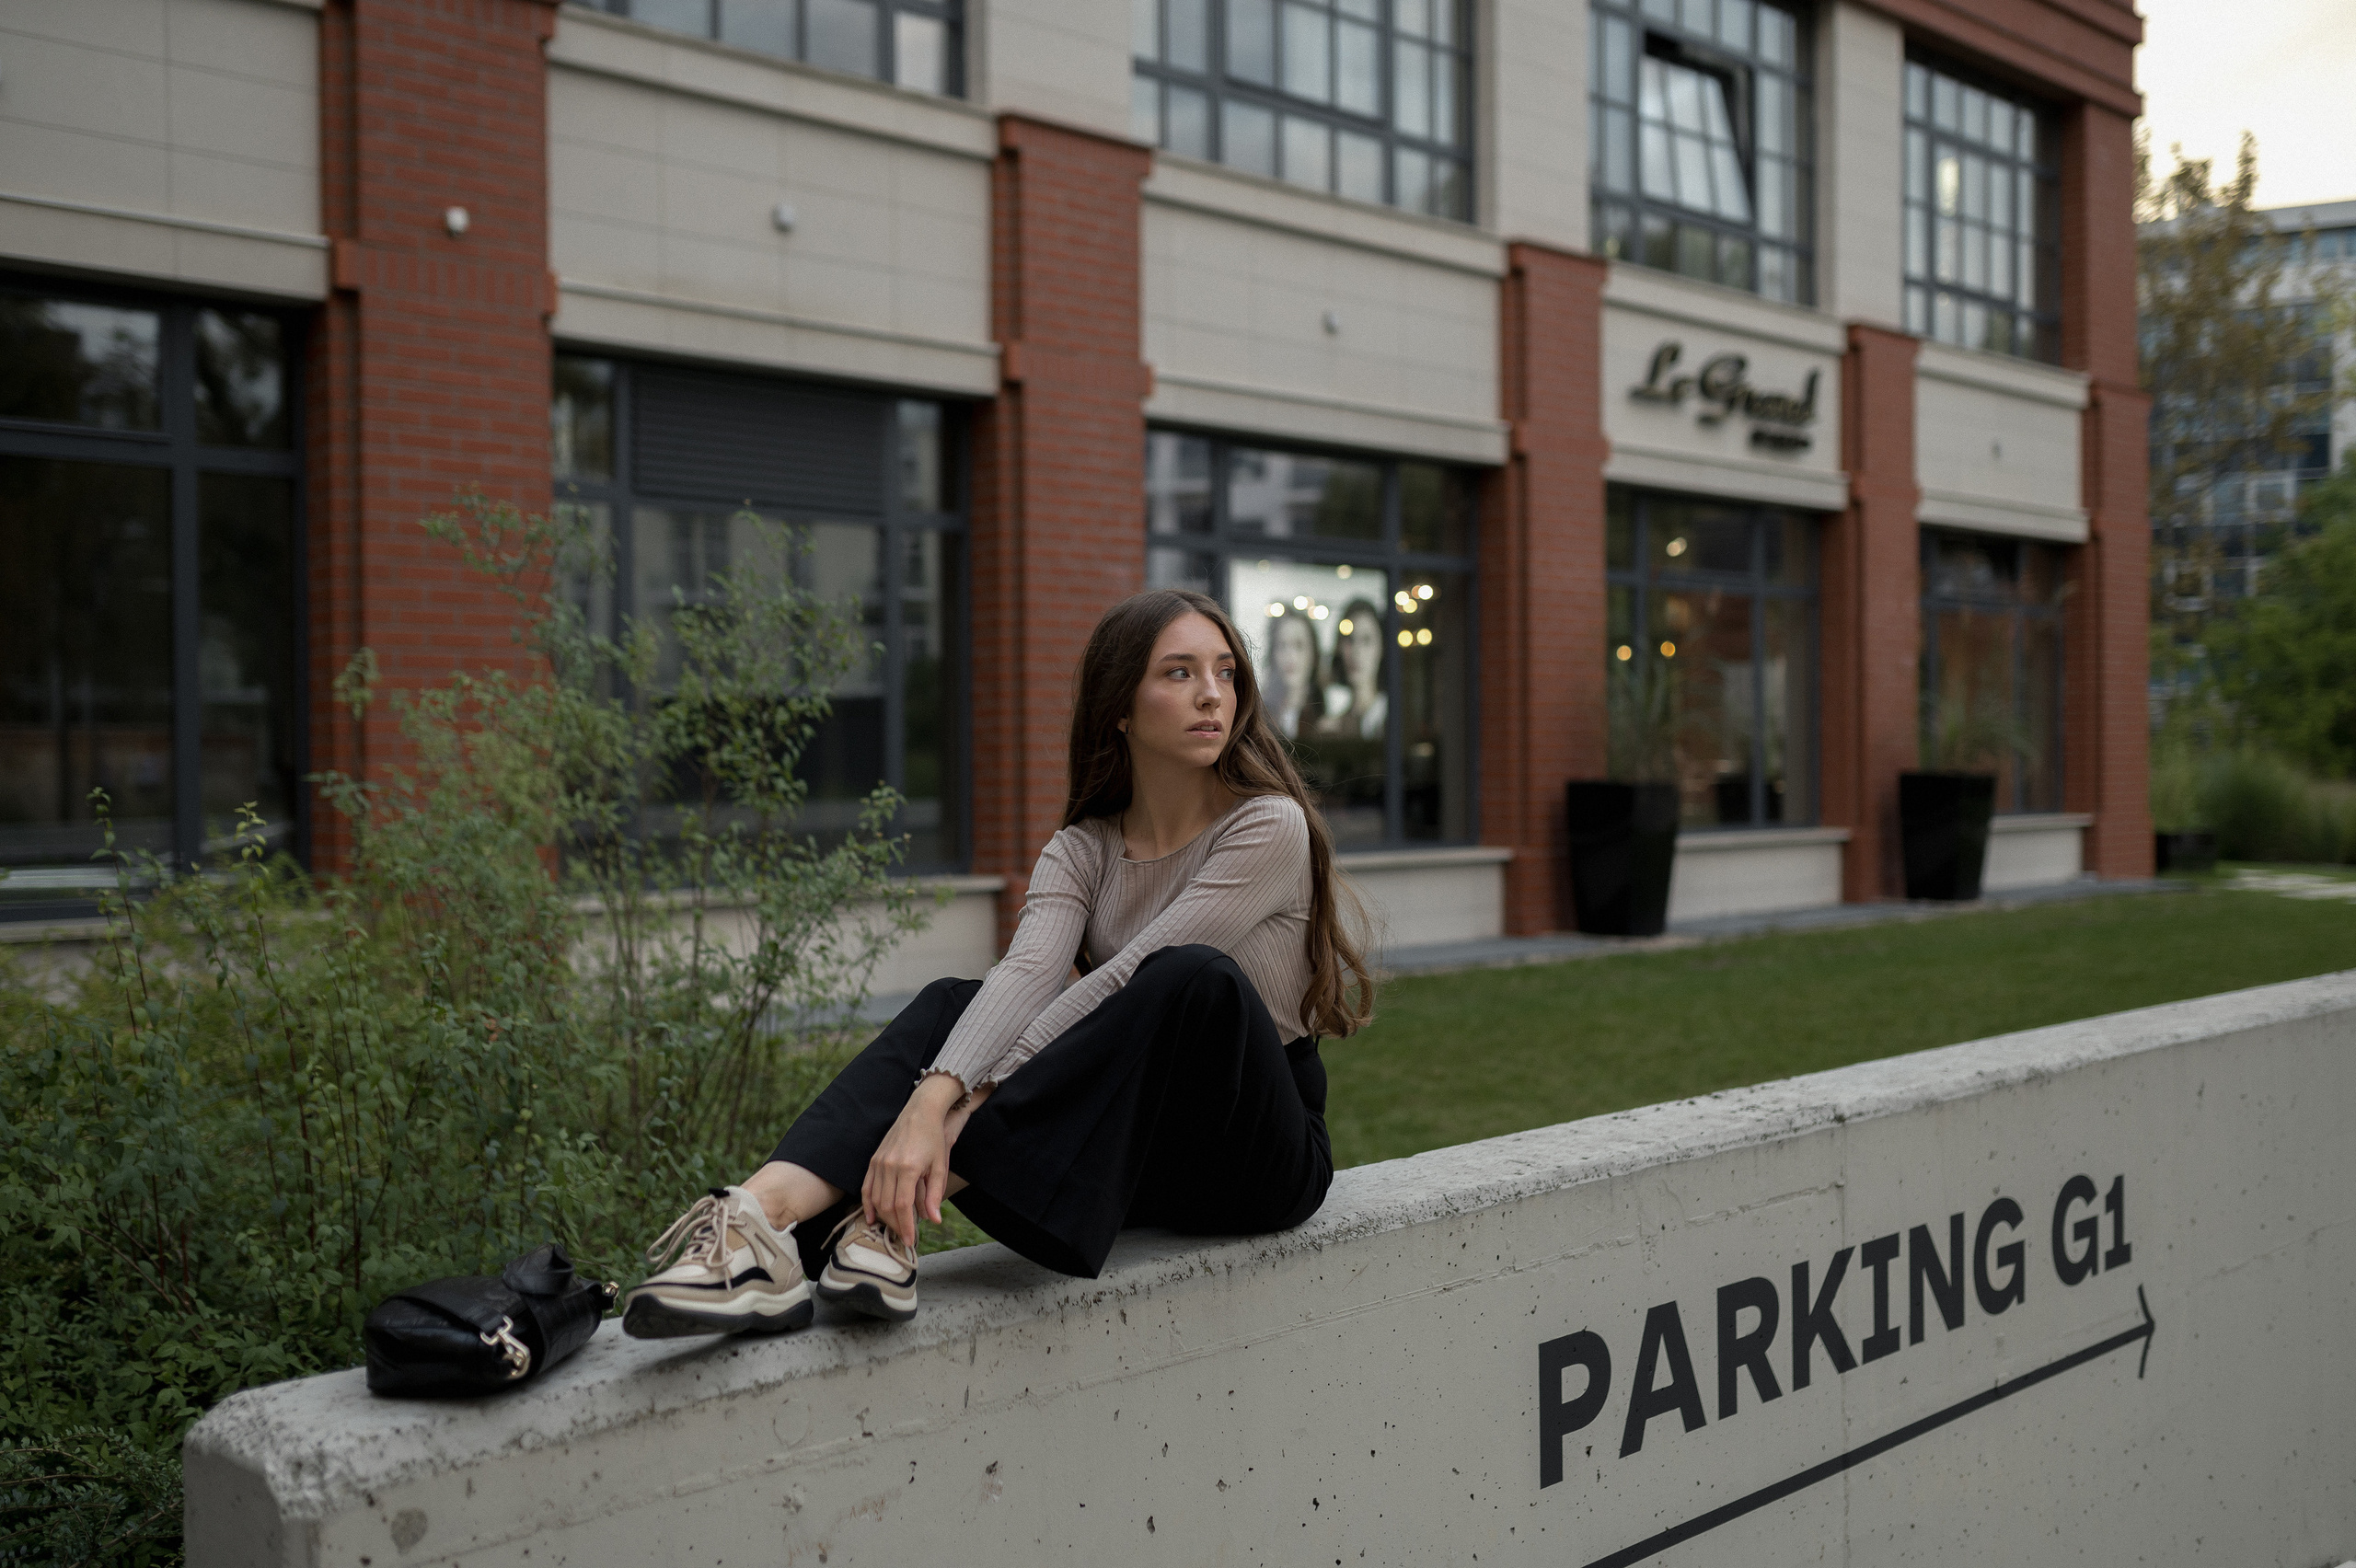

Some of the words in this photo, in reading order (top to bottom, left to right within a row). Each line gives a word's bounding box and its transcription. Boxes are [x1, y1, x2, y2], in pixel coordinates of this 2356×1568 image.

[1628, 341, 1695, 405] Le
[1538, 1197, 2026, 1491] PARKING
[2051, 1173, 2132, 1286] G1
